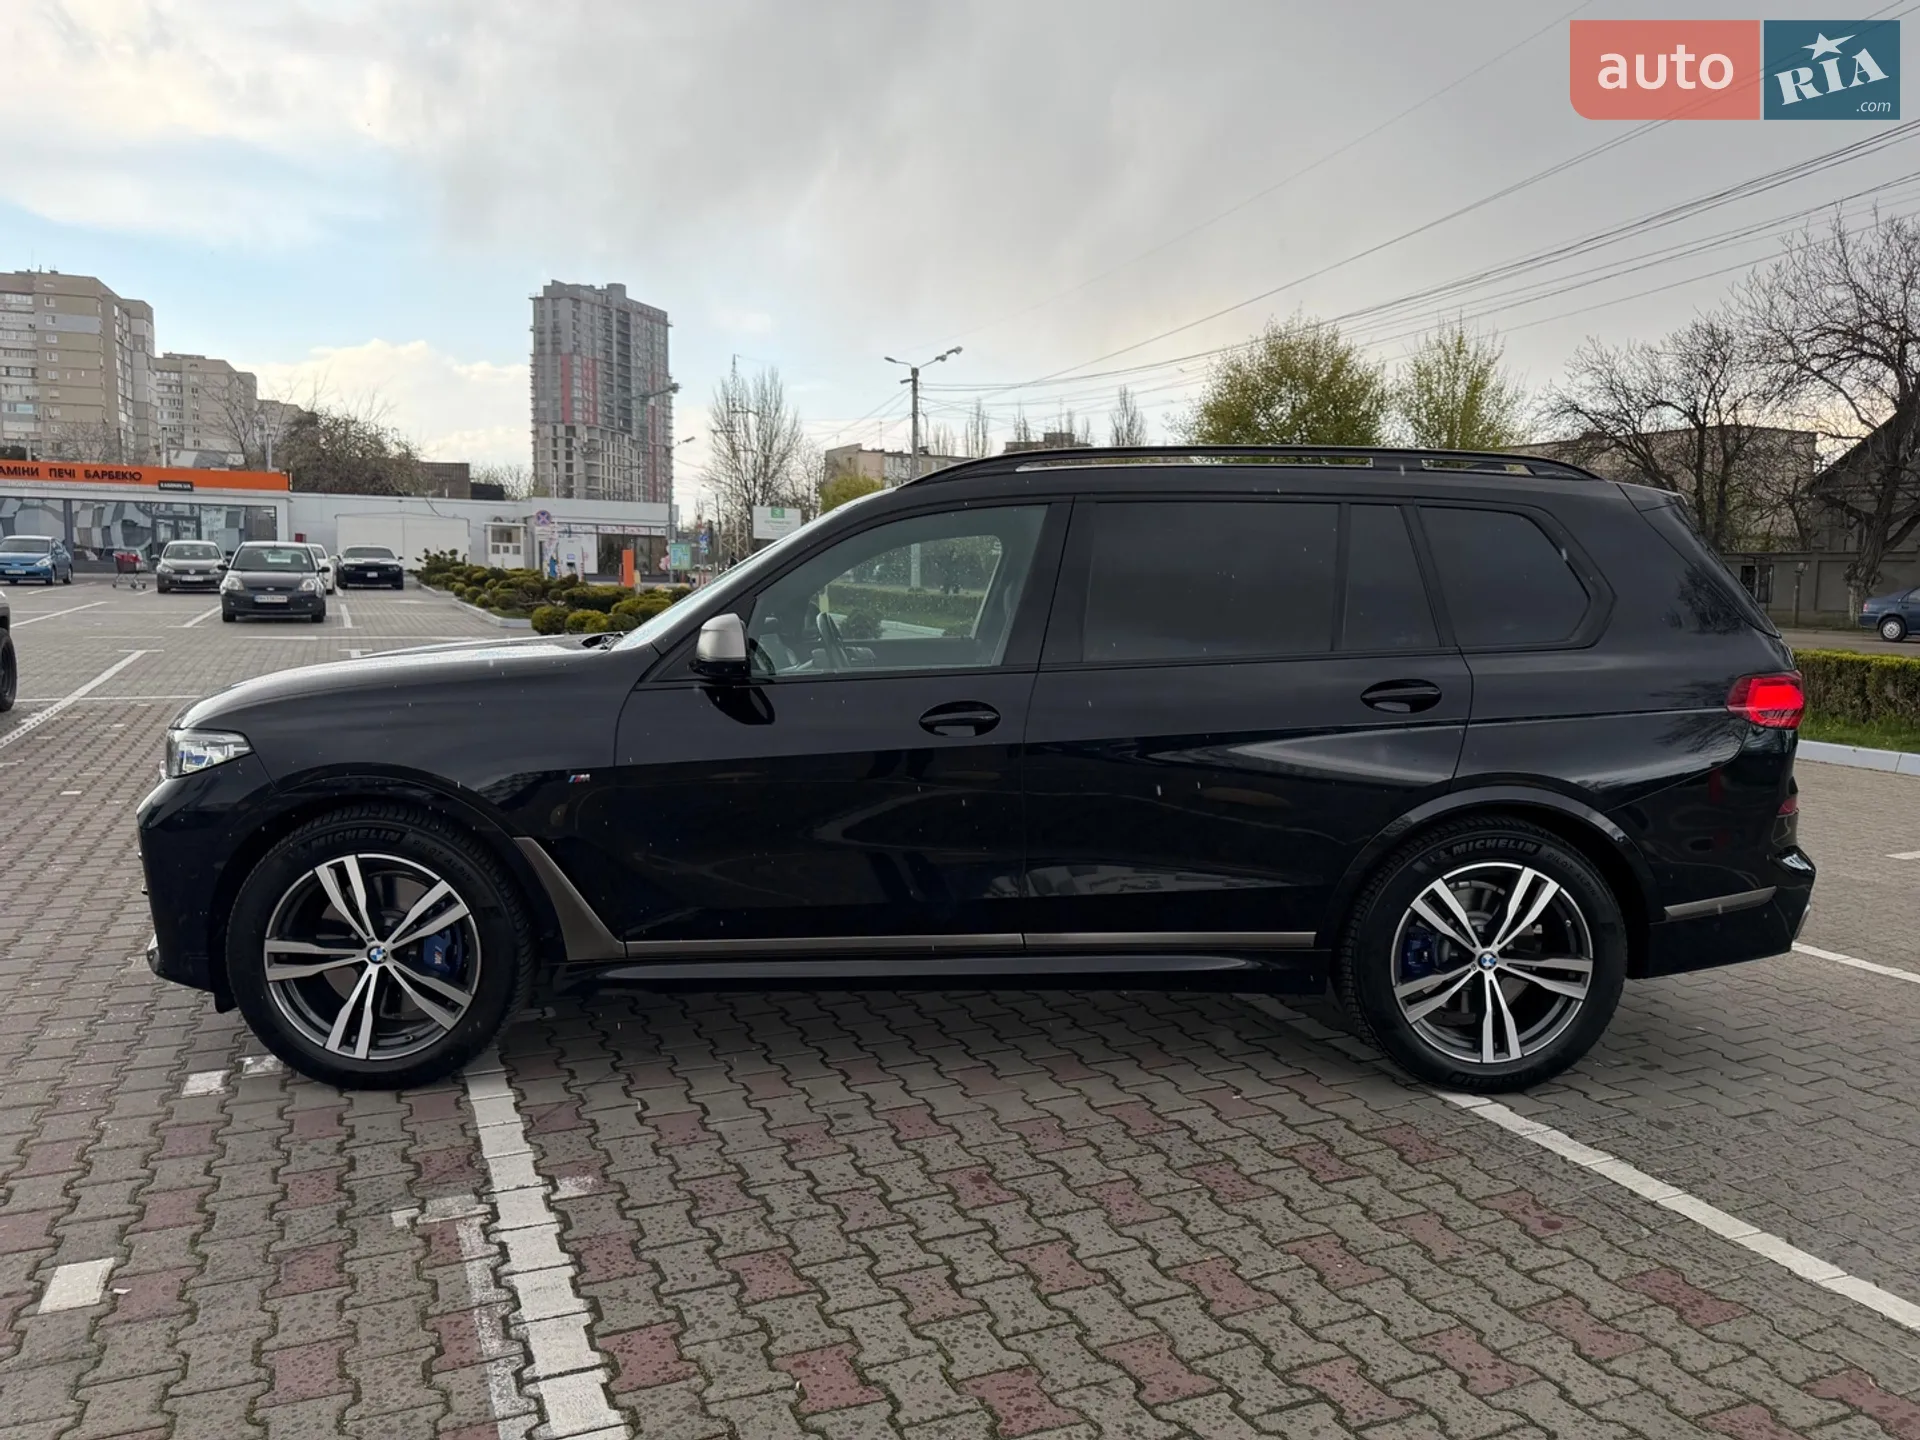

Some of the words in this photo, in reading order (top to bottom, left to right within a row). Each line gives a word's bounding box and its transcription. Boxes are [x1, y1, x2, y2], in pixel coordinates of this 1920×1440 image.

[48, 467, 76, 479] ПЕЧІ
[84, 469, 143, 481] БАРБЕКЮ
[310, 828, 401, 847] MICHELIN
[1452, 838, 1539, 856] MICHELIN
